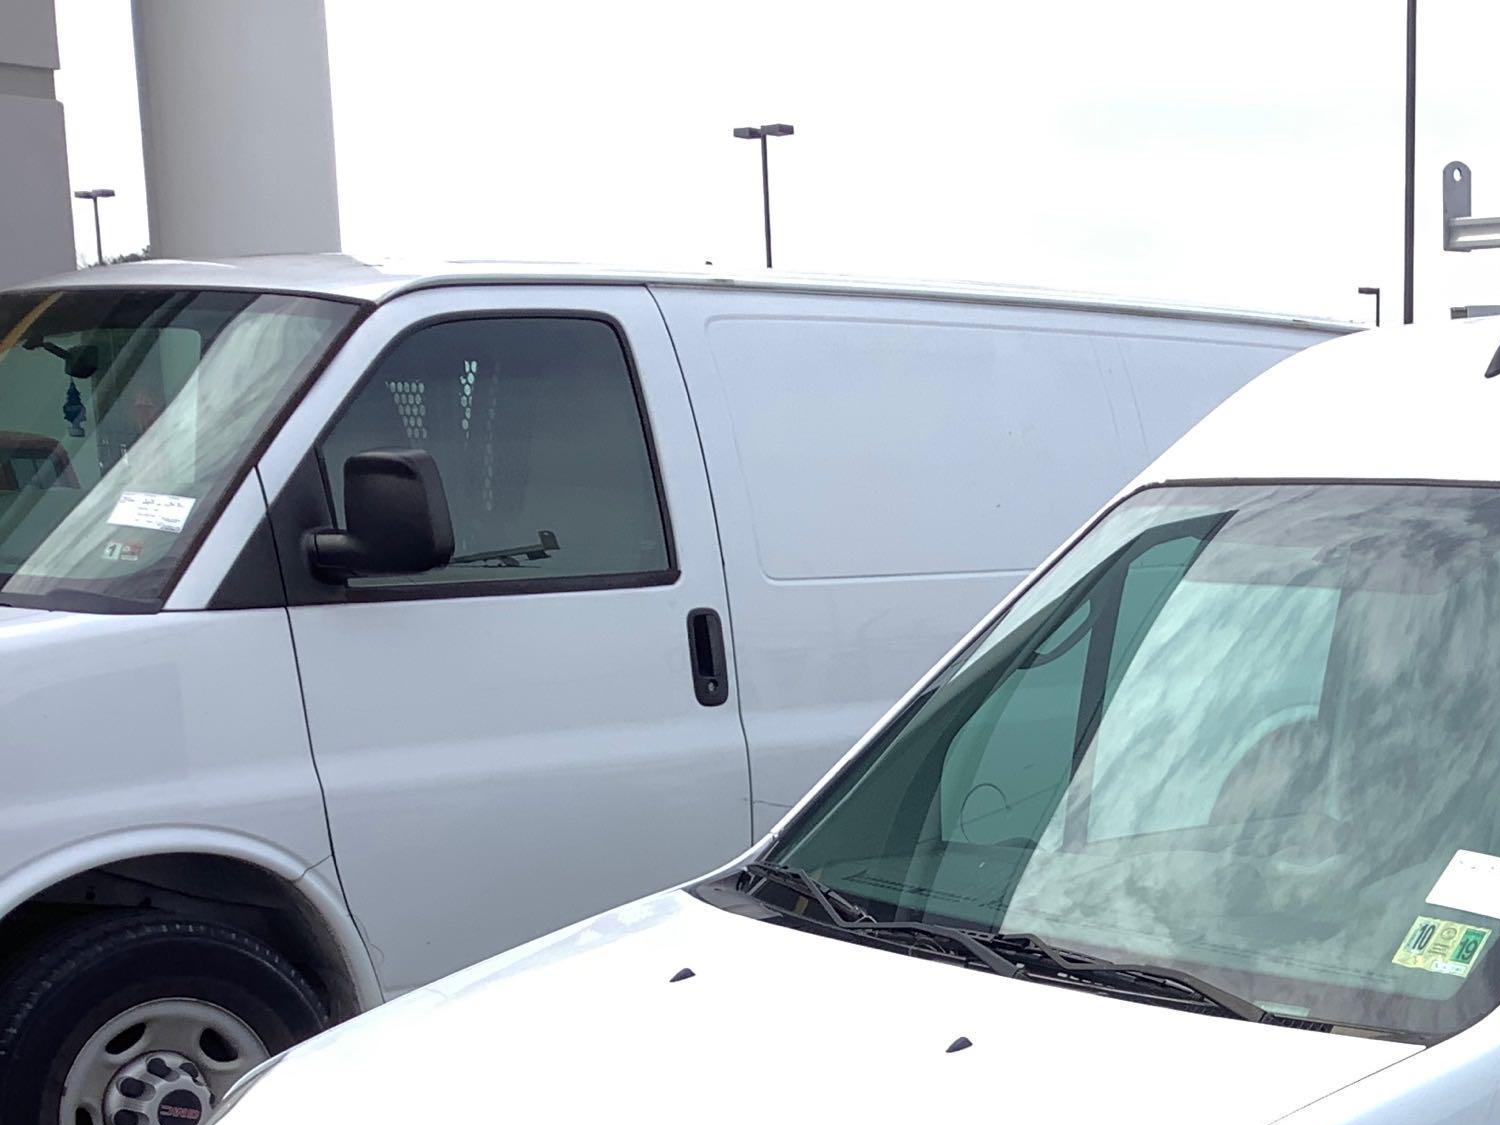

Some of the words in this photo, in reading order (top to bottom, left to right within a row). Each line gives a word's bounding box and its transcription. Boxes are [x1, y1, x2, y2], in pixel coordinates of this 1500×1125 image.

[1411, 923, 1436, 951] 10
[1455, 938, 1479, 961] 19
[159, 1104, 200, 1120] GMC
